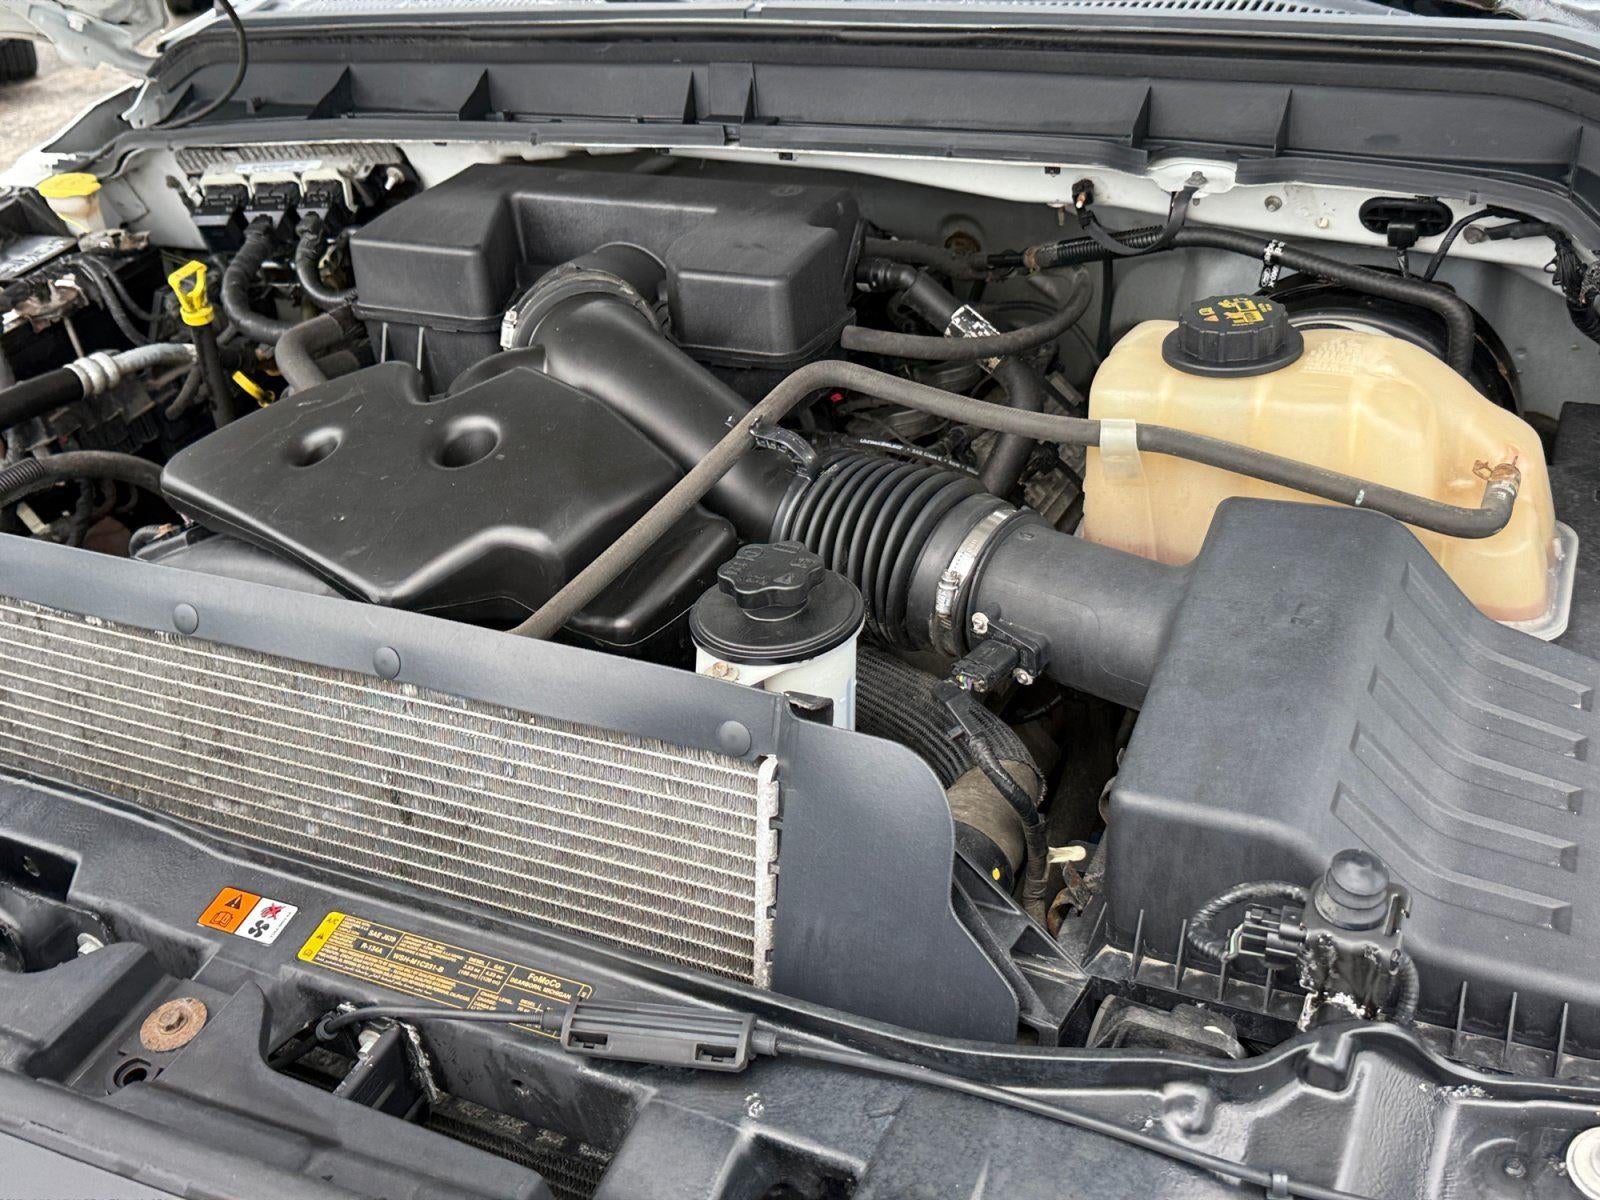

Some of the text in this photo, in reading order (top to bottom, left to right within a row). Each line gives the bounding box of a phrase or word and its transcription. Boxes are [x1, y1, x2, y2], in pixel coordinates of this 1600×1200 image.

[360, 942, 383, 954] R-134A
[527, 972, 561, 989] FoMoCo
[542, 985, 572, 1000] MICHIGAN
